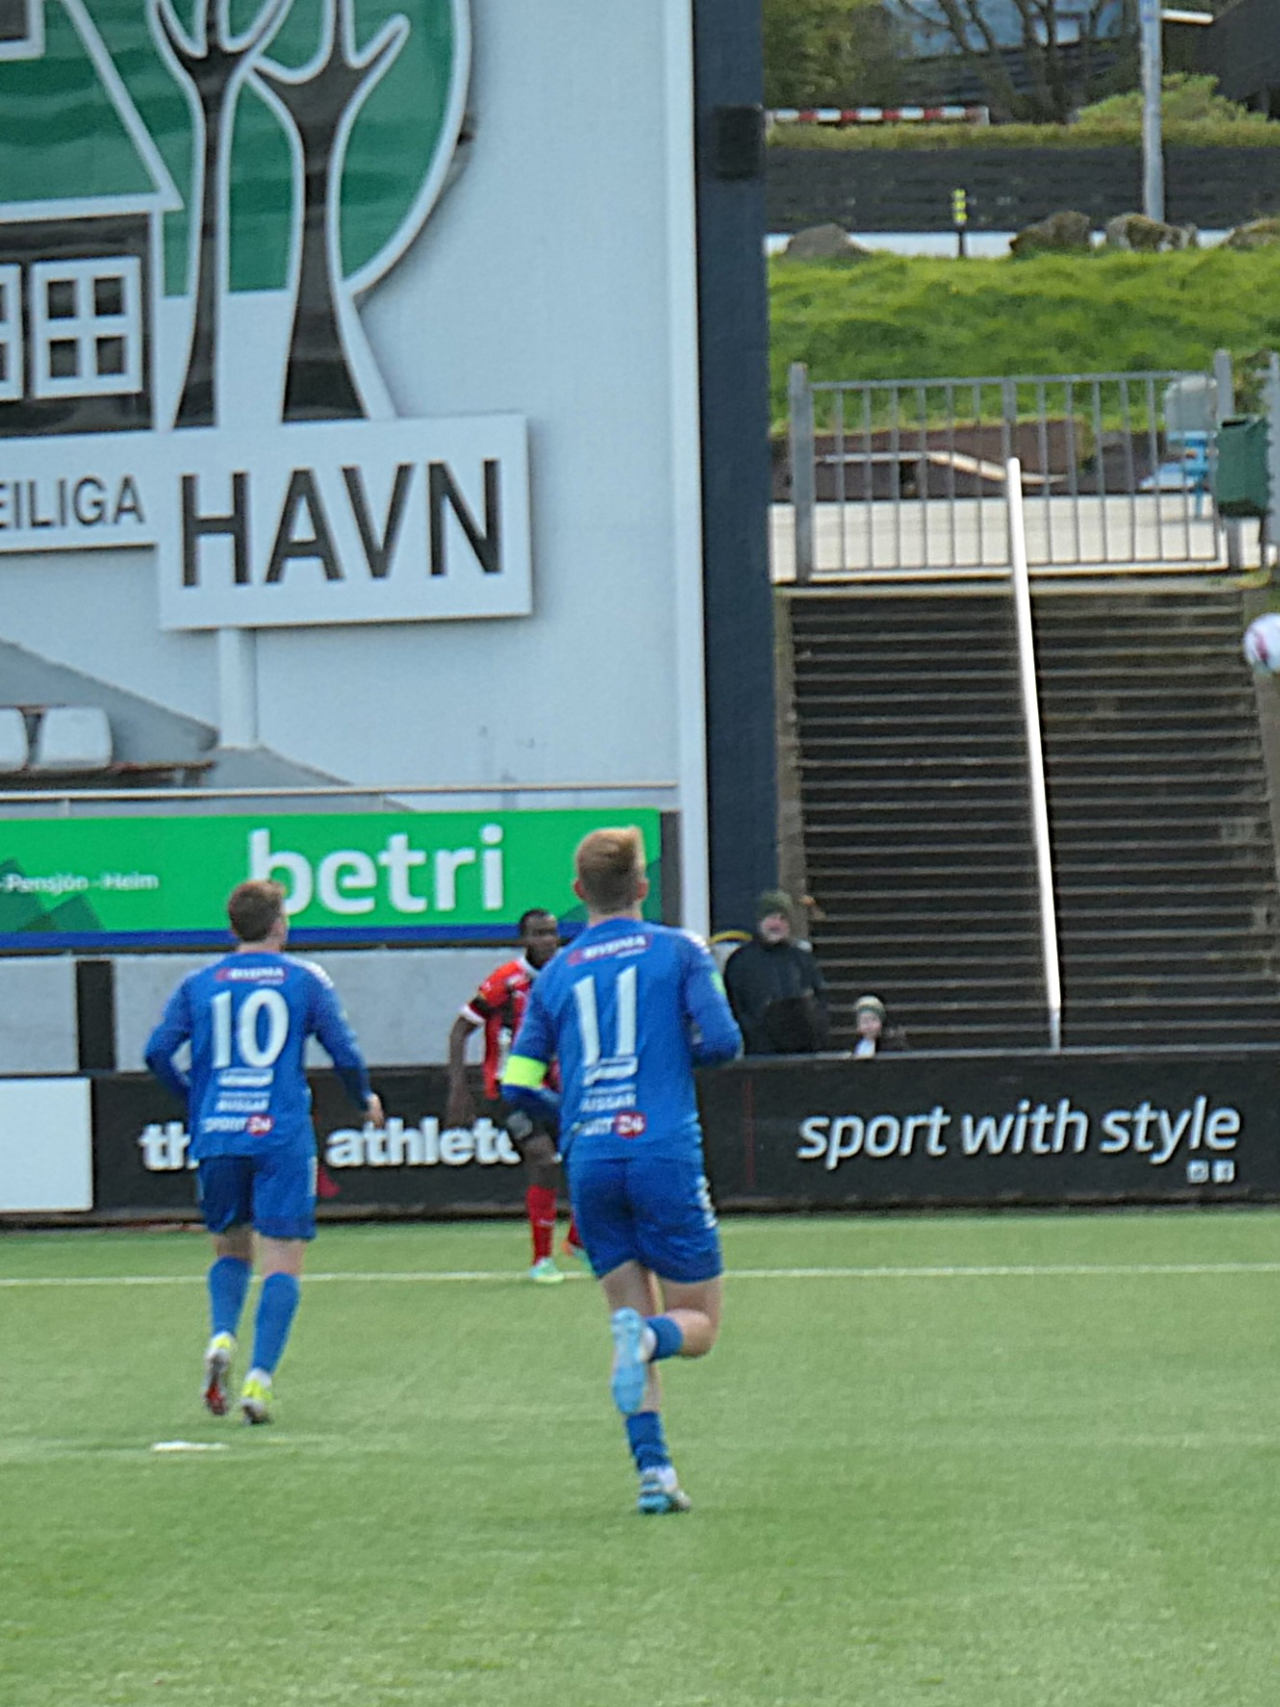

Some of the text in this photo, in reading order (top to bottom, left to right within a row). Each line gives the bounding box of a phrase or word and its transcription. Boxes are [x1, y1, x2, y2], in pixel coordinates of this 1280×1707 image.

[181, 458, 502, 587] HAVN
[250, 823, 503, 915] betri
[211, 987, 289, 1069] 10
[574, 964, 637, 1068] 11
[139, 1122, 199, 1171] th
[798, 1095, 1242, 1170] sport with style
